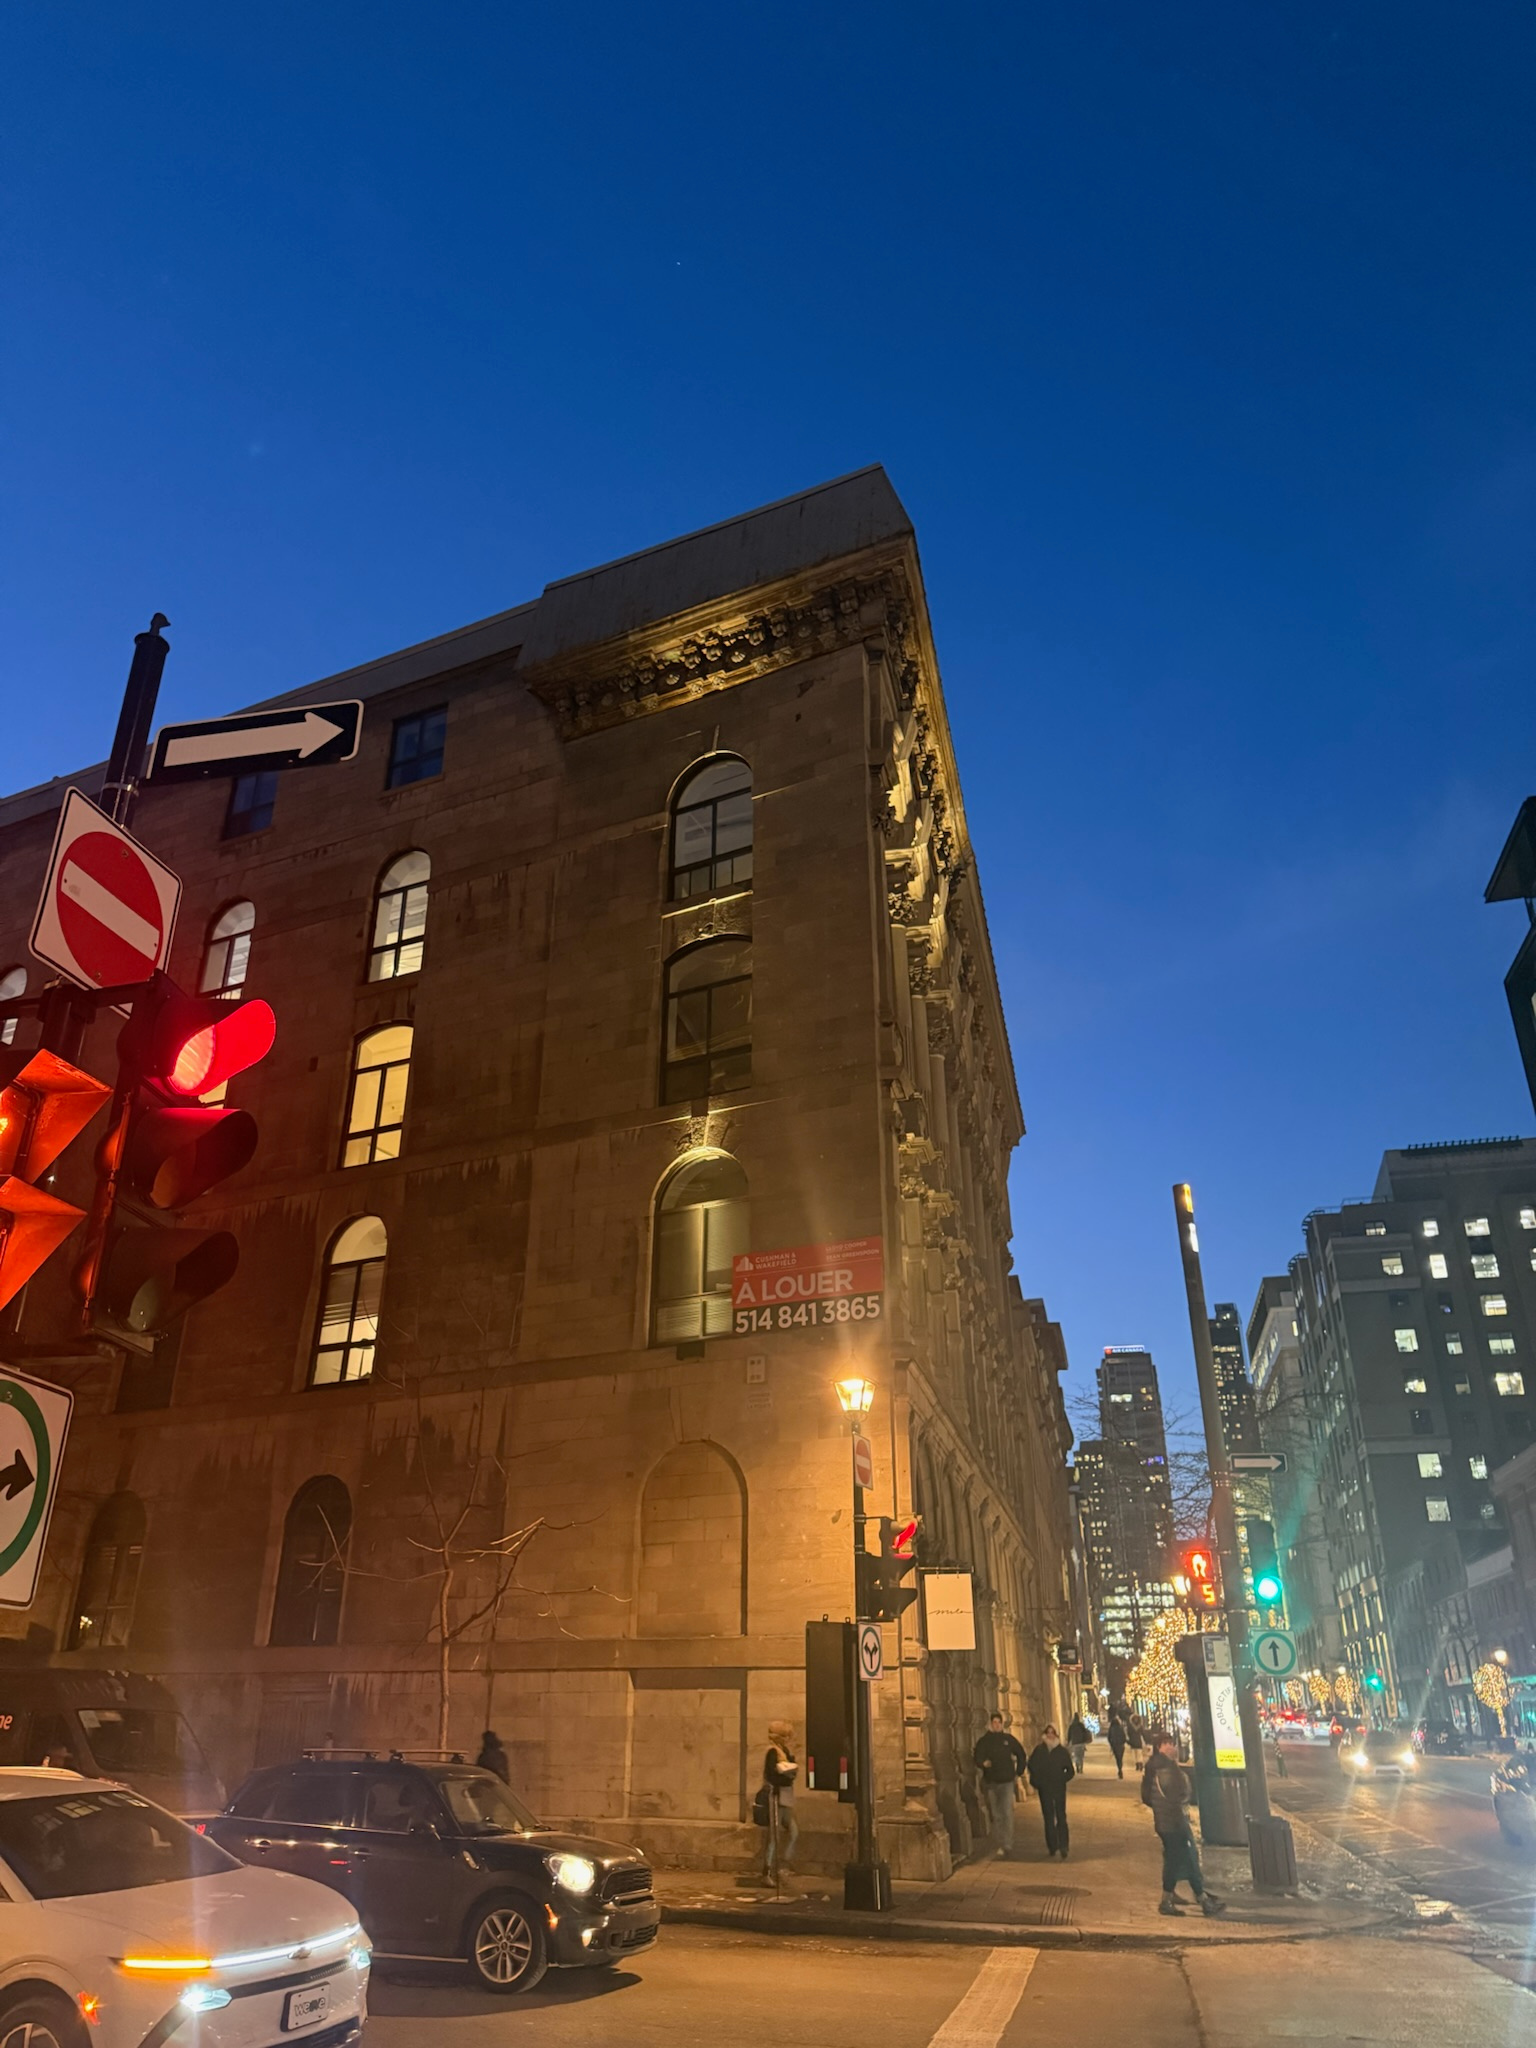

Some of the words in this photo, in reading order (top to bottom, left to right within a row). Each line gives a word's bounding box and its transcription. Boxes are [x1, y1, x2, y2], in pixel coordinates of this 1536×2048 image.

[755, 1254, 790, 1264] CUSHMAN
[755, 1258, 797, 1270] WAKEFIELD
[735, 1277, 756, 1304] À
[762, 1269, 853, 1301] LOUER
[735, 1308, 773, 1334] 514
[778, 1302, 817, 1329] 841
[822, 1295, 880, 1323] 3865
[1202, 1584, 1215, 1602] 5
[1216, 1686, 1232, 1726] OBJECTIF
